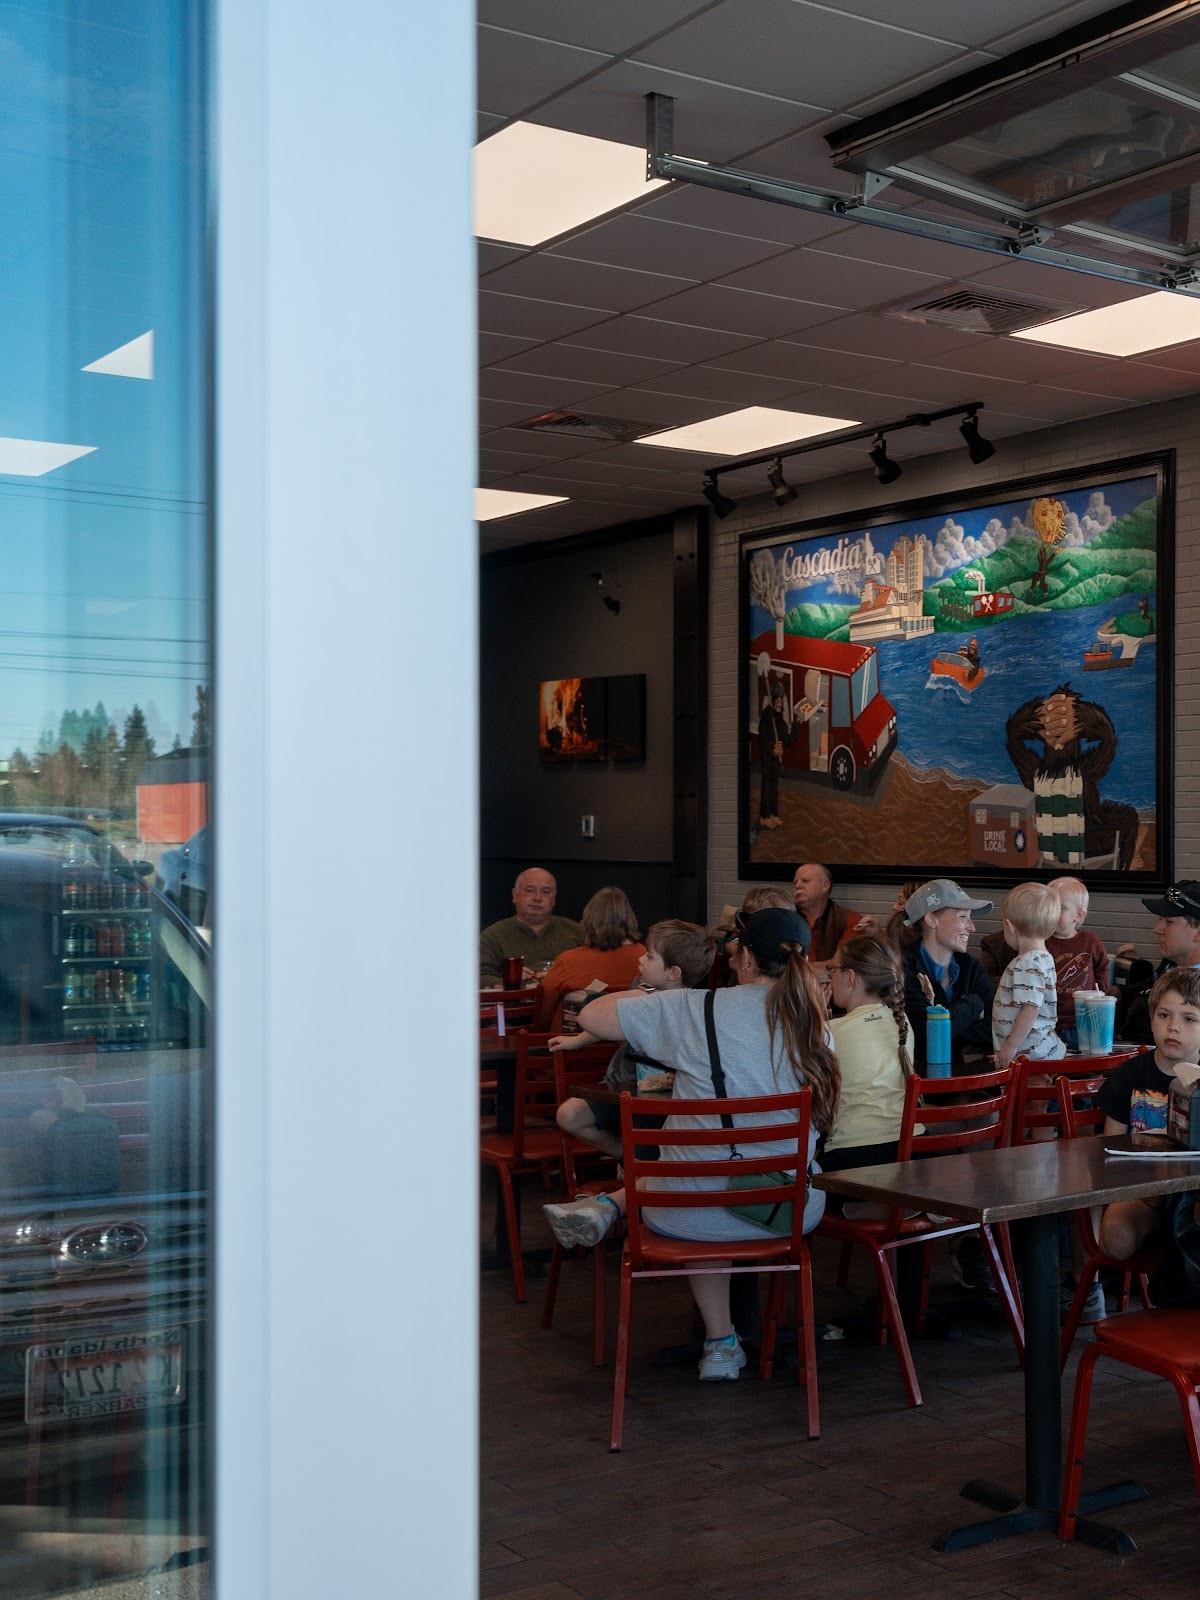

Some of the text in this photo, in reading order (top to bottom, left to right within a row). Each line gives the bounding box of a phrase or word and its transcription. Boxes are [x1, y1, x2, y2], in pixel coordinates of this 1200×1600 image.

[782, 537, 862, 582] Cascadia
[984, 830, 1006, 842] DRINK
[984, 841, 1007, 853] LOCAL
